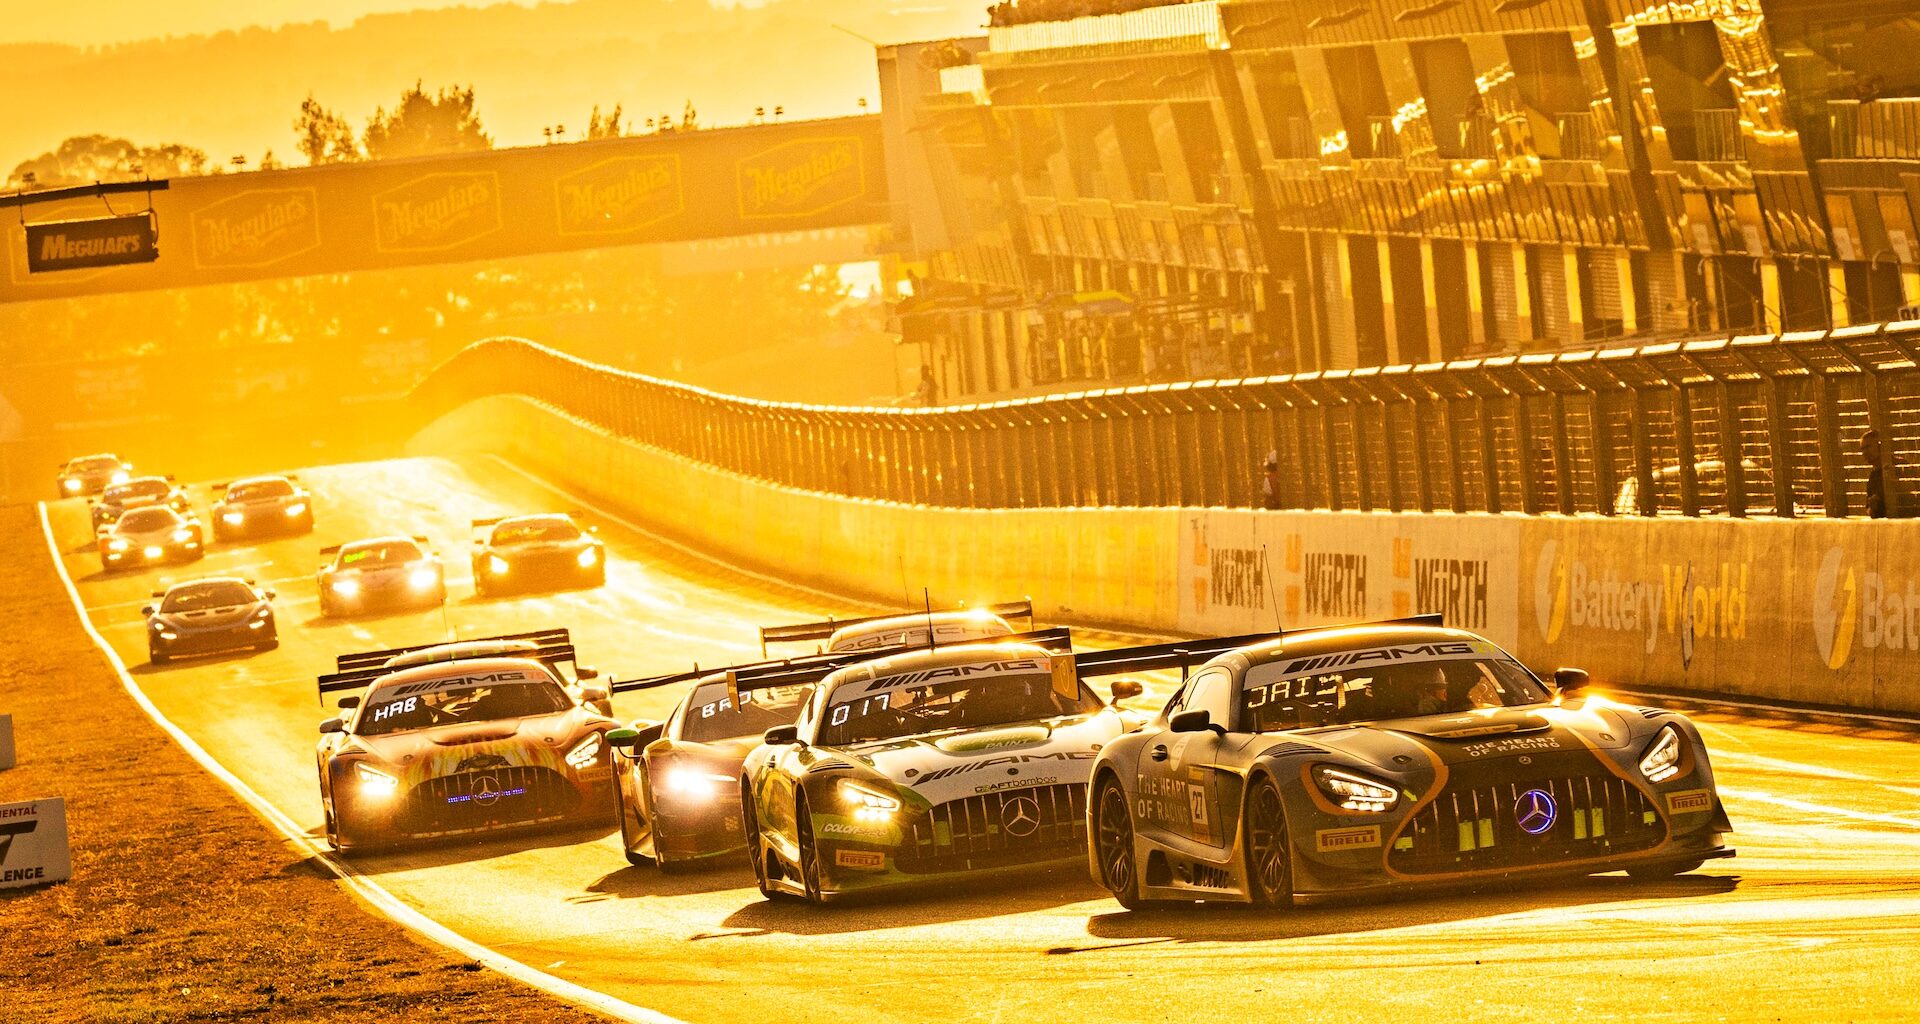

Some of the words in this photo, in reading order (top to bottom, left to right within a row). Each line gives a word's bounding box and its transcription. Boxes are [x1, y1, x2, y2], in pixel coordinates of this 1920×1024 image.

[1211, 548, 1264, 610] WÜRTH
[1304, 553, 1367, 618] WÜRTH
[1415, 559, 1488, 629] WÜRTH
[1346, 643, 1474, 664] AMG
[921, 659, 1038, 681] AMG
[435, 672, 525, 689] AMG
[374, 696, 418, 722] HAB
[985, 738, 1030, 749] PAINT
[1462, 741, 1497, 752] THE
[1501, 737, 1556, 746] HEART
[1470, 749, 1490, 757] OF
[1497, 742, 1561, 752] RACING
[1138, 774, 1158, 796] THE
[1160, 777, 1186, 799] HEART
[1193, 790, 1203, 820] 27
[1671, 793, 1707, 809] PIRELLI
[0, 806, 37, 818] ENTAL
[1138, 798, 1153, 819] OF
[1157, 801, 1190, 825] RACING
[1321, 830, 1375, 847] PIRELLI
[840, 852, 881, 866] PIRELLI
[0, 866, 45, 882] ENGE
